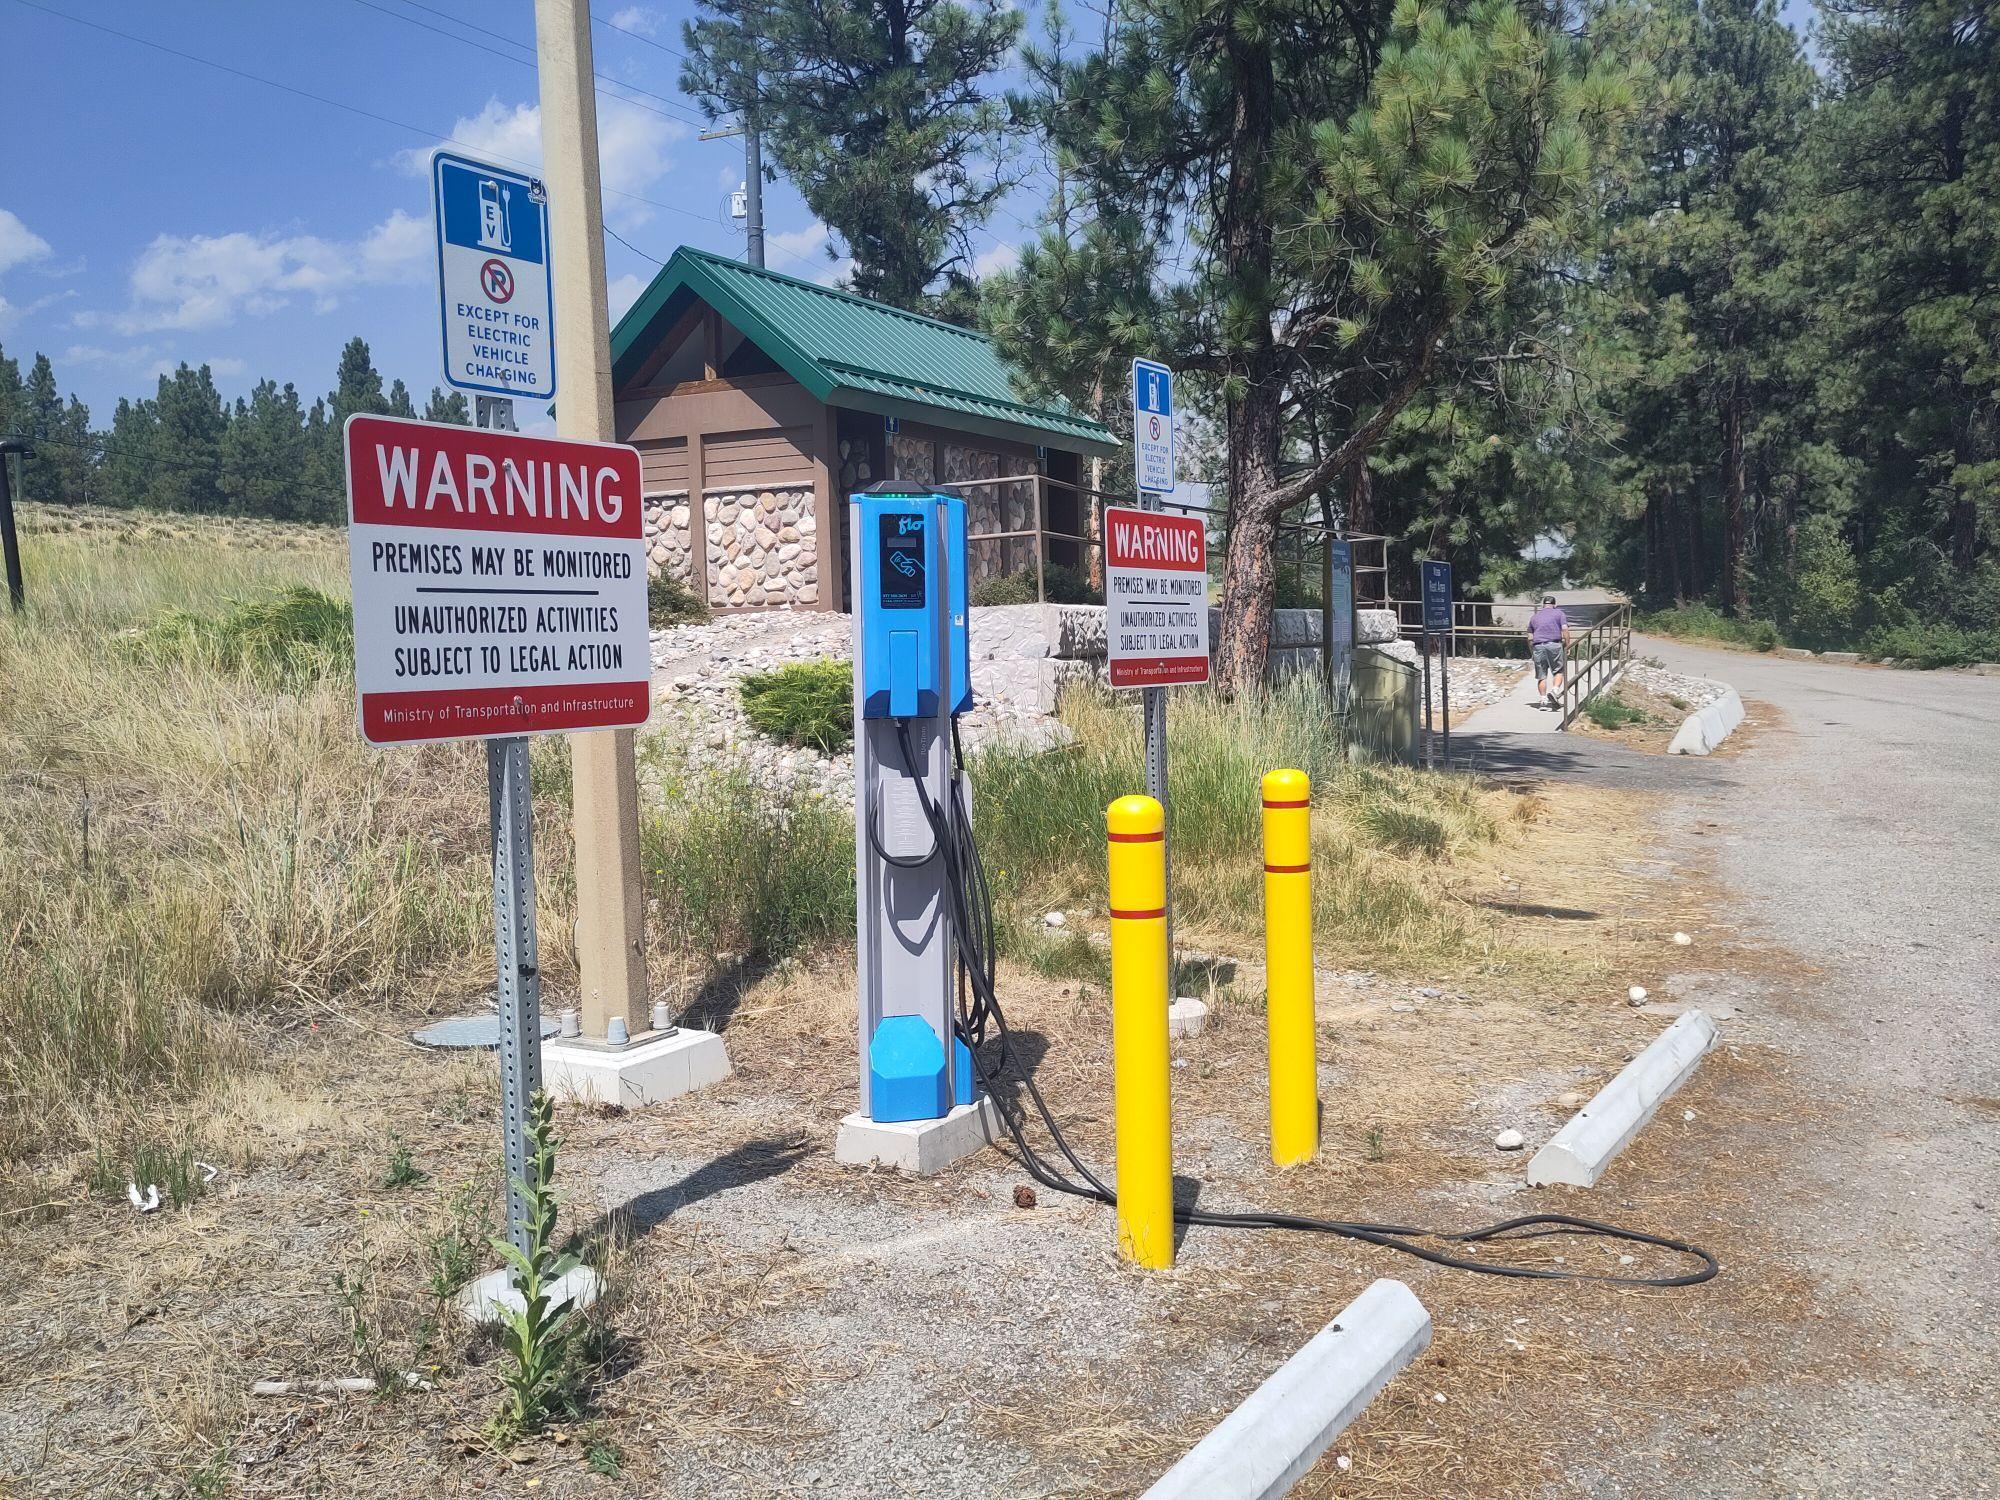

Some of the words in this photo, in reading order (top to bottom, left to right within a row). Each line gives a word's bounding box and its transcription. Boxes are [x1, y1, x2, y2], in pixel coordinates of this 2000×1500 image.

[457, 304, 509, 326] EXCEPT
[514, 314, 540, 330] FOR
[468, 325, 531, 347] ELECTRIC
[472, 344, 529, 365] VEHICLE
[466, 362, 537, 384] CHARGING
[1142, 442, 1159, 452] EXCEPT
[1160, 446, 1169, 454] FOR
[1145, 454, 1166, 464] ELECTRIC
[1146, 464, 1166, 474] VEHICLE
[376, 444, 624, 524] WARNING
[898, 517, 925, 535] flo
[1114, 522, 1199, 564] WARNING
[372, 542, 462, 575] PREMISES
[472, 547, 505, 576] MAY
[514, 548, 535, 577] BE
[544, 550, 632, 580] MONITORED
[1114, 576, 1144, 594] PREMISES
[1146, 578, 1158, 595] MAY
[1160, 579, 1168, 595] BE
[1170, 579, 1202, 596] MONITORED
[394, 606, 527, 634] UNAUTHORIZED
[536, 606, 619, 633] ACTIVITIES
[1120, 611, 1166, 628] UNAUTHORIZED
[1168, 612, 1198, 628] ACTIVITIES
[1120, 634, 1146, 651] SUBJECT
[1149, 634, 1157, 650] TO
[1160, 634, 1177, 650] LEGAL
[1178, 634, 1199, 649] ACTION
[394, 646, 472, 677] SUBJECT
[480, 646, 500, 674] TO
[510, 644, 560, 673] LEGAL
[568, 644, 622, 670] ACTION
[1116, 668, 1134, 678] Ministry
[1134, 667, 1140, 676] of
[1140, 666, 1169, 677] Transportaon
[1177, 664, 1204, 674] Infrastructure
[384, 705, 434, 723] Ministry
[439, 706, 450, 719] of
[455, 701, 537, 720] Transportation
[541, 698, 560, 713] and
[562, 697, 634, 712] Infrastructure
